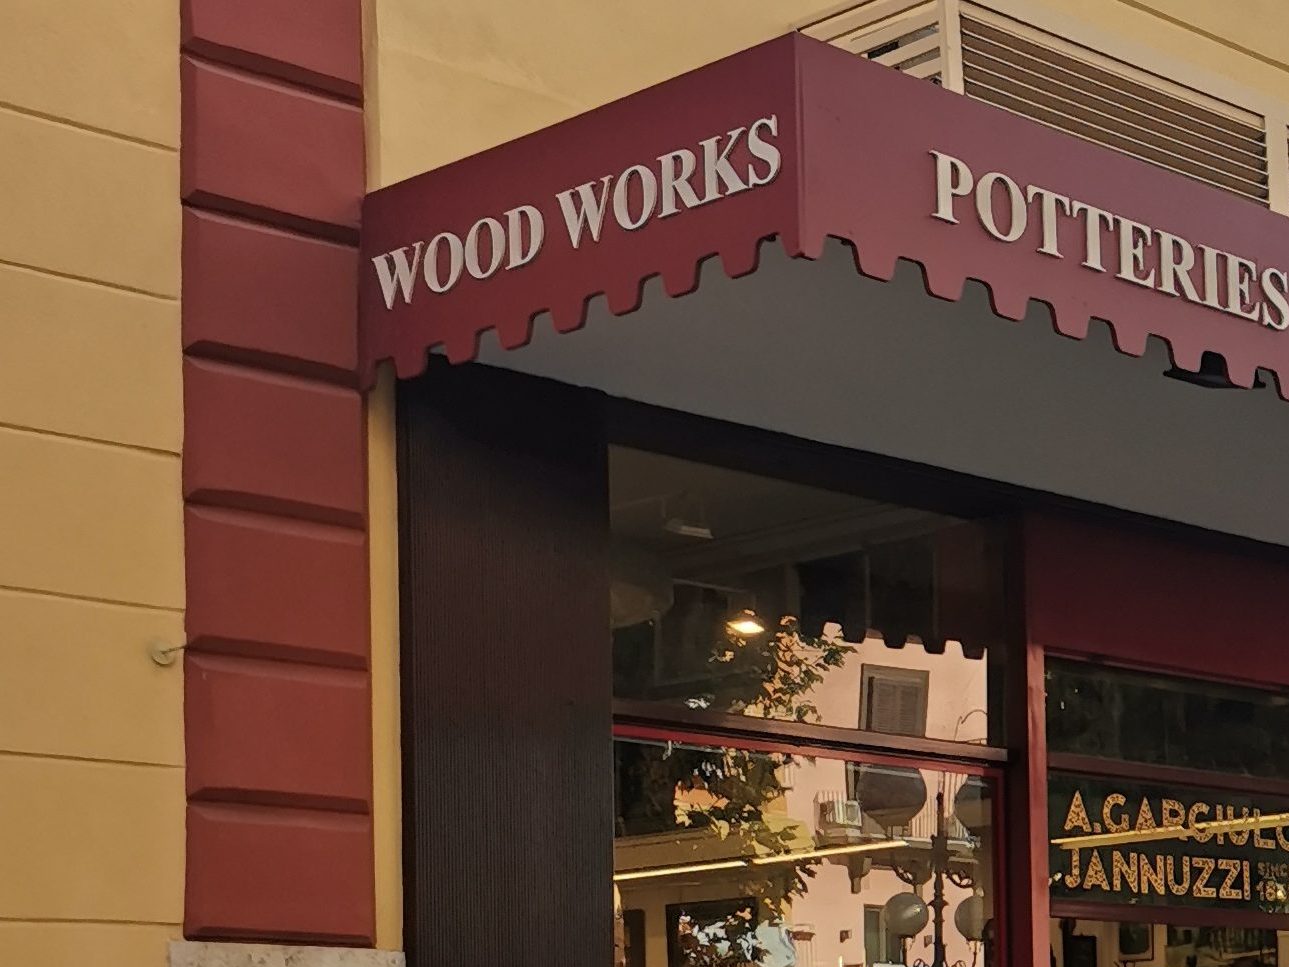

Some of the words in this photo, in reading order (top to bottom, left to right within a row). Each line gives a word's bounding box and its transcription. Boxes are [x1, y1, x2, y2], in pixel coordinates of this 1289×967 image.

[371, 204, 545, 311] WOOD
[555, 113, 782, 249] WORKS
[1065, 848, 1250, 900] JANNUZZI
